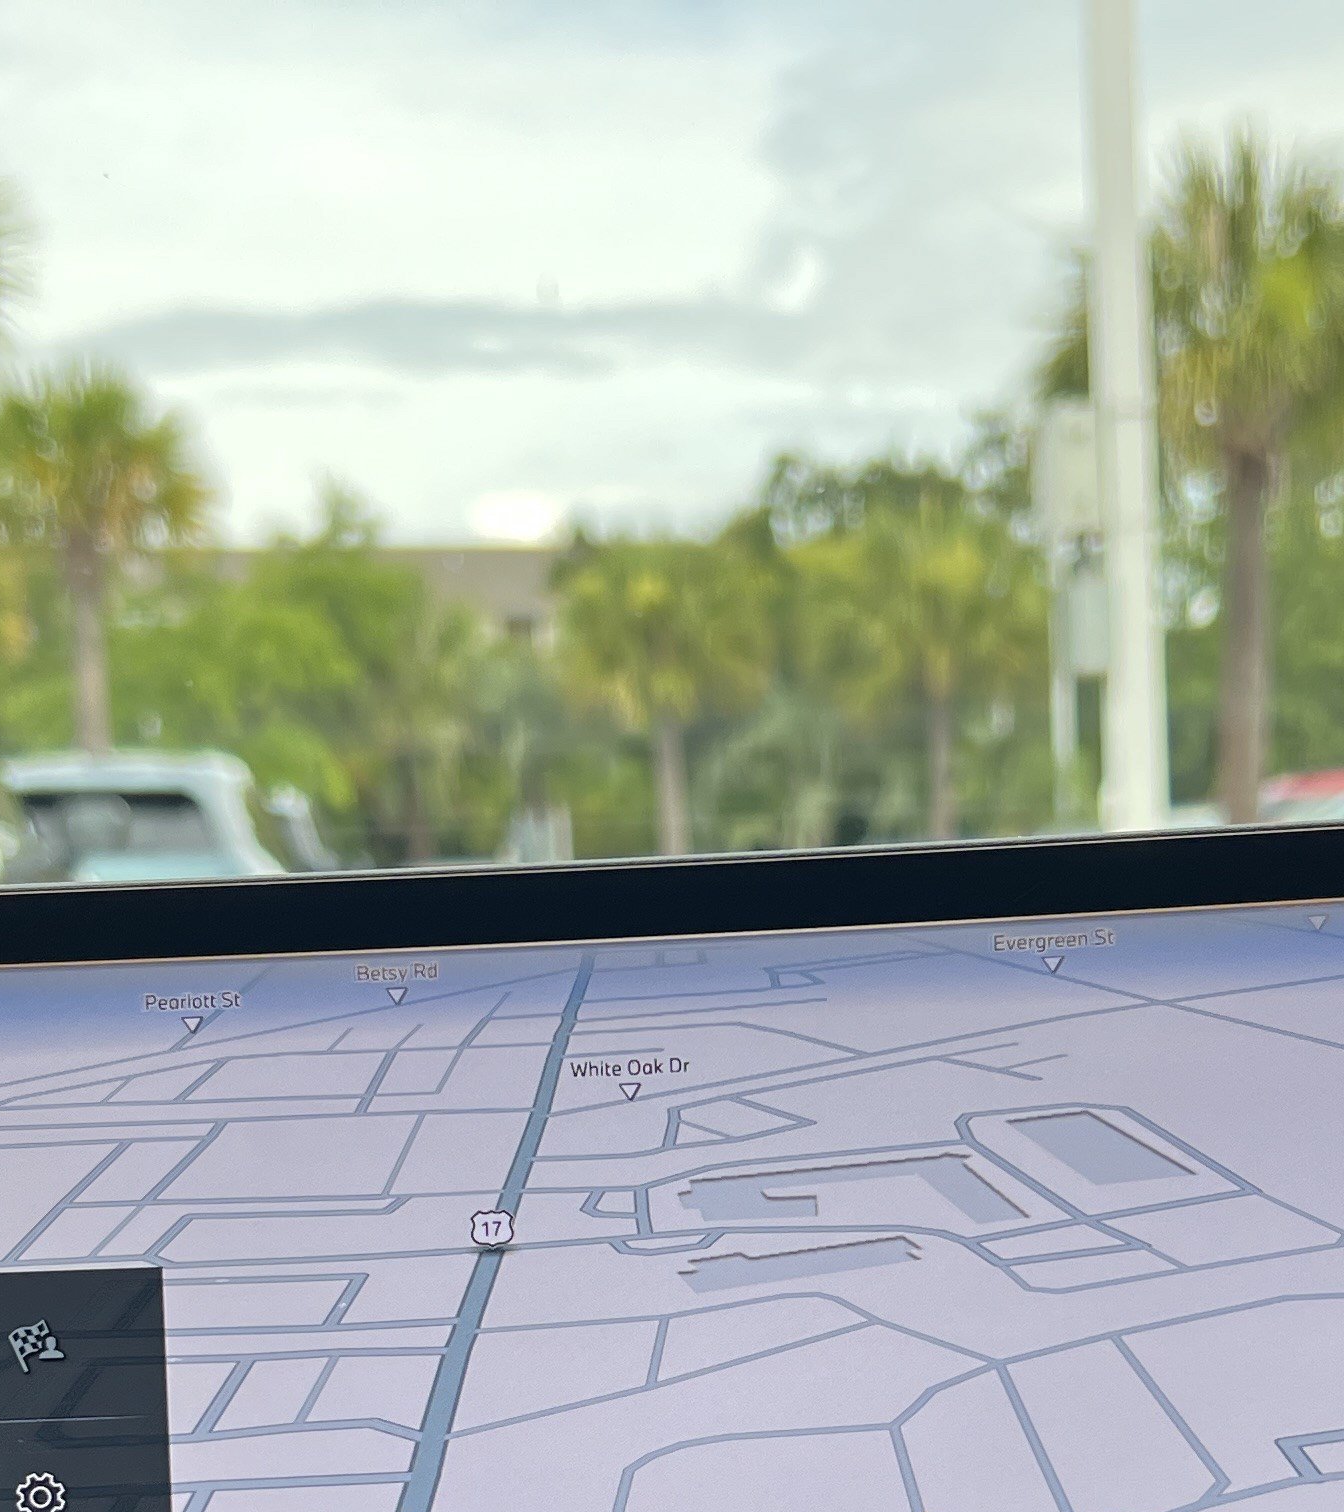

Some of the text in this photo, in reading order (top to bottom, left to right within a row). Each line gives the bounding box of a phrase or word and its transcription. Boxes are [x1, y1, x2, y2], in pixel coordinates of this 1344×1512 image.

[994, 928, 1114, 953] Evergreen St
[357, 963, 438, 983] Betsy Rd
[145, 991, 240, 1010] Pearlott St
[570, 1057, 689, 1077] White Oak Dr
[482, 1221, 502, 1237] 17
